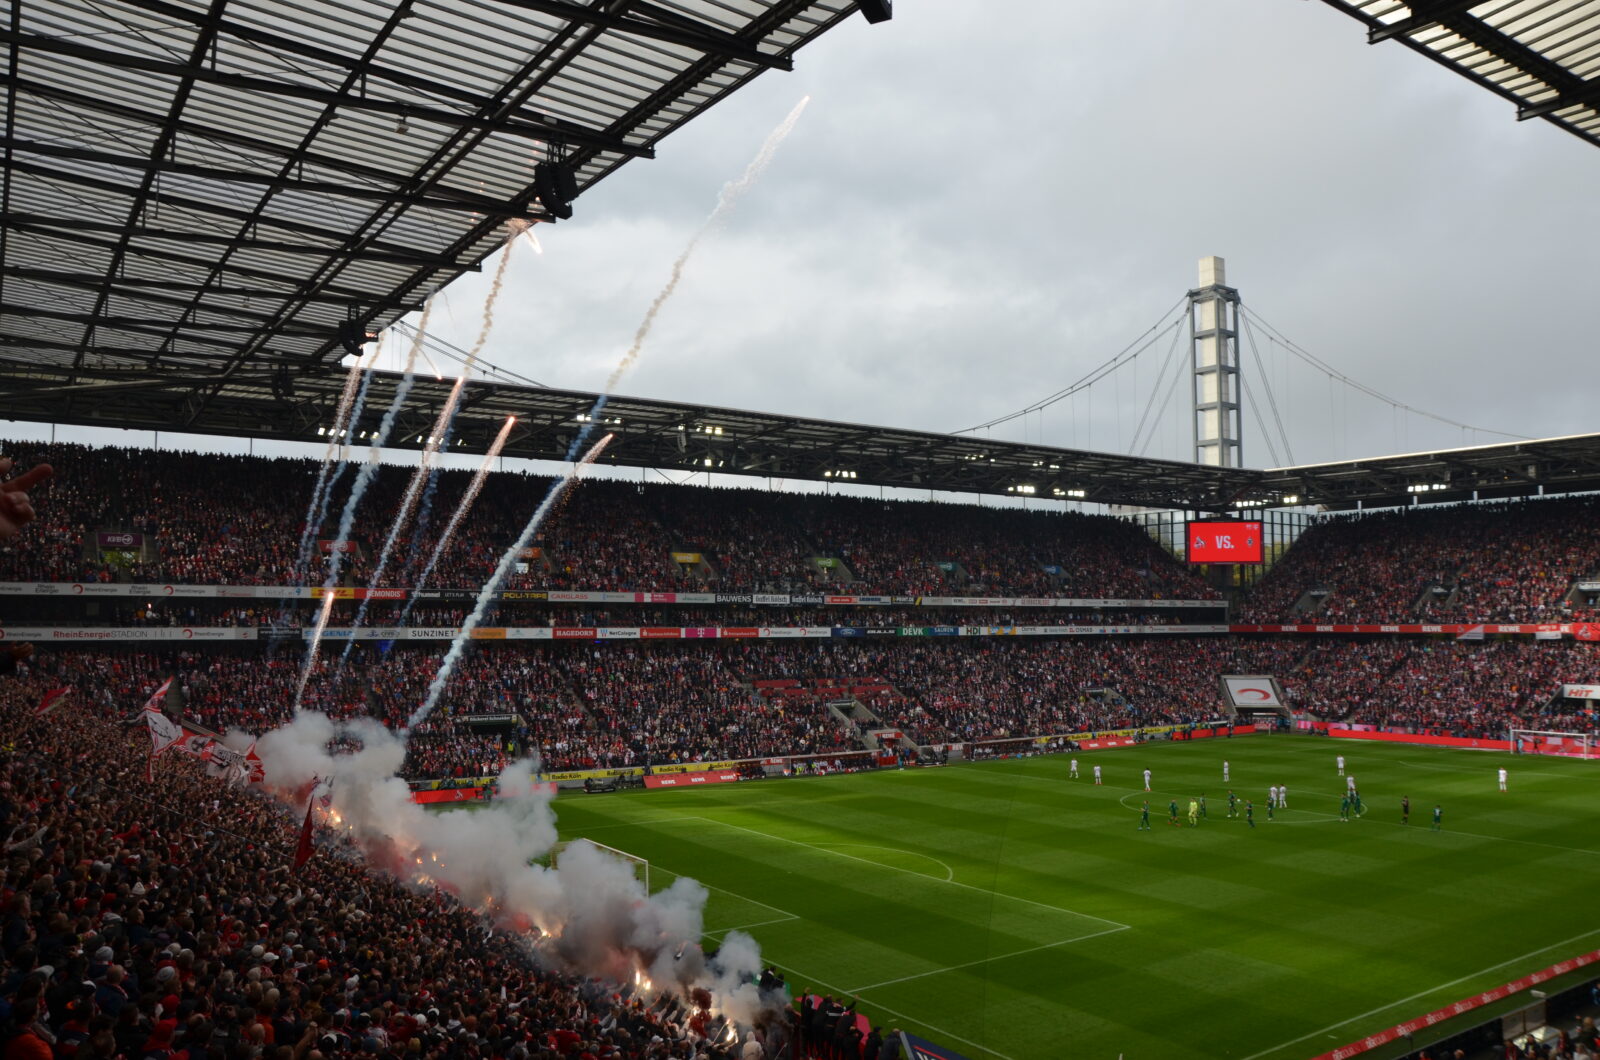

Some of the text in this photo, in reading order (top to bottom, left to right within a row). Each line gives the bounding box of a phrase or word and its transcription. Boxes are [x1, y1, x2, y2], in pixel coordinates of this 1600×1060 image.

[1215, 535, 1235, 549] VS.
[411, 630, 455, 638] SUNZINET
[902, 627, 924, 636] DEVK
[1568, 689, 1594, 698] HIT
